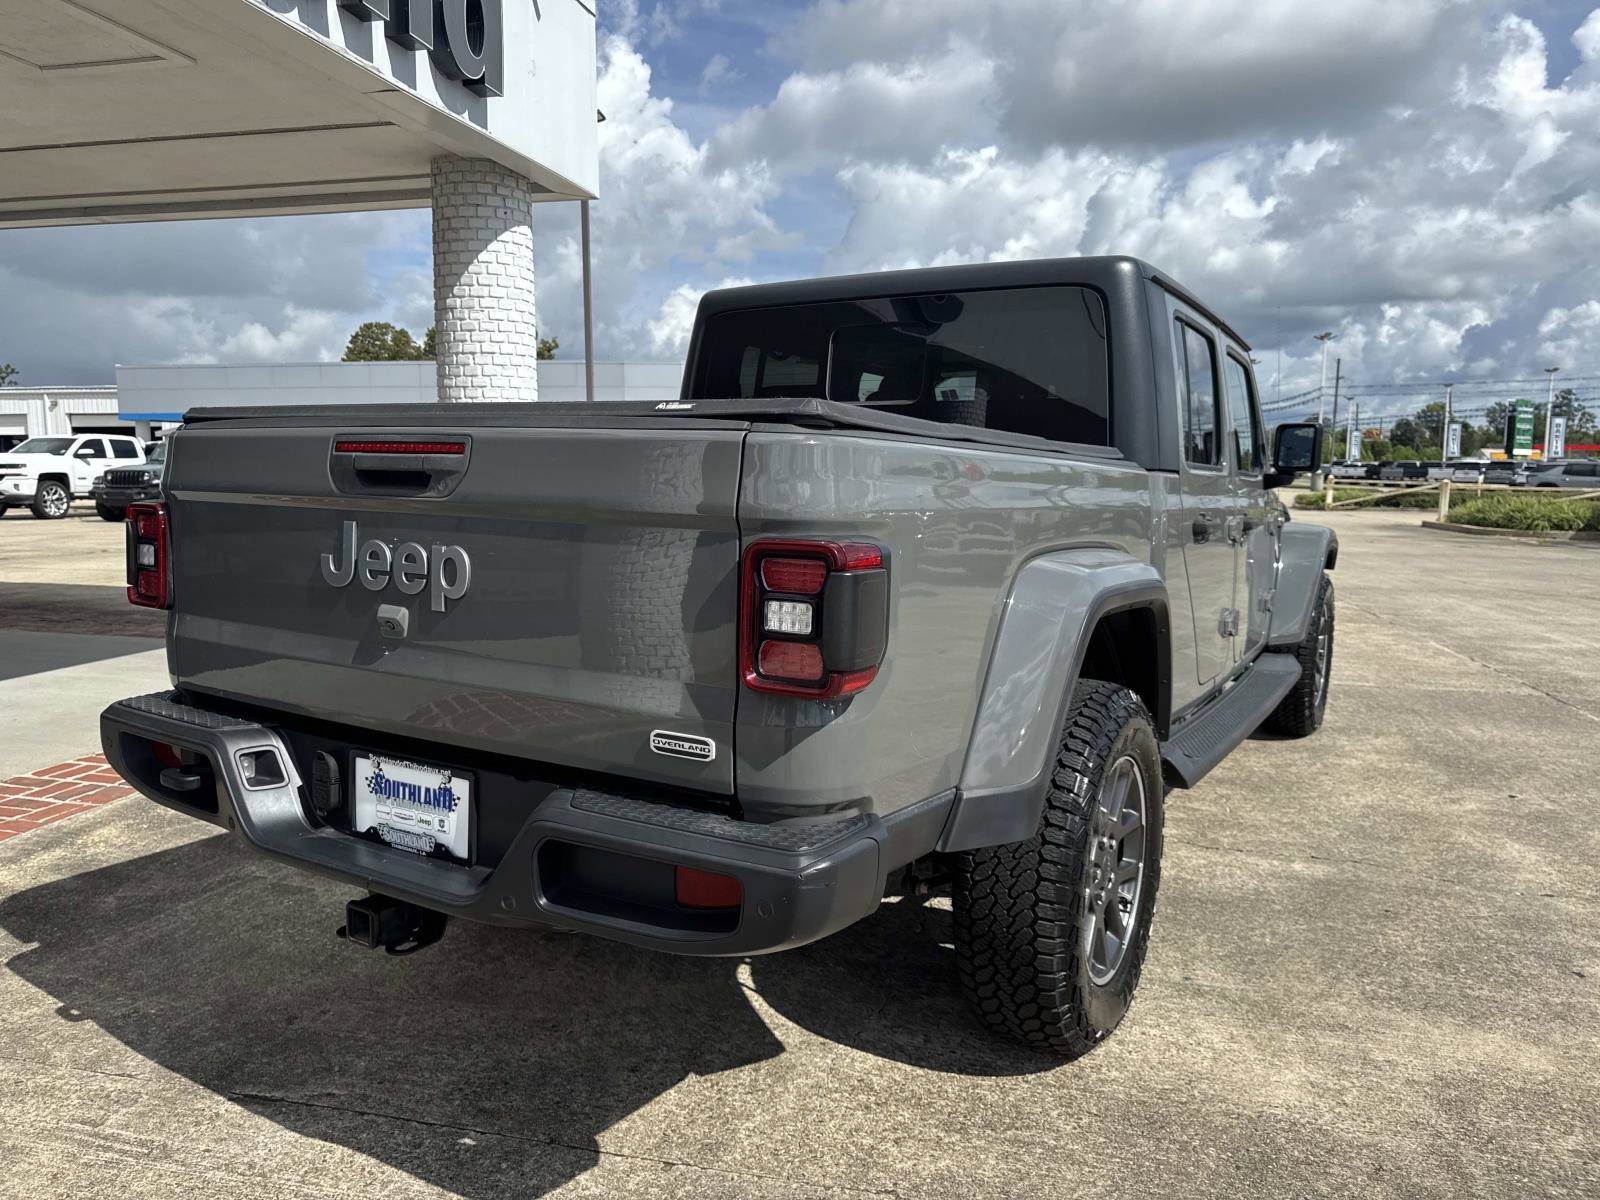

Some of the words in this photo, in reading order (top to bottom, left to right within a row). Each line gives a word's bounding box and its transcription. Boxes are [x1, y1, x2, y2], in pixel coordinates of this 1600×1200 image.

[320, 520, 471, 612] Jeep
[652, 738, 711, 754] OVERLAND
[374, 771, 453, 813] SOUTHLAND
[417, 816, 432, 827] Jeep
